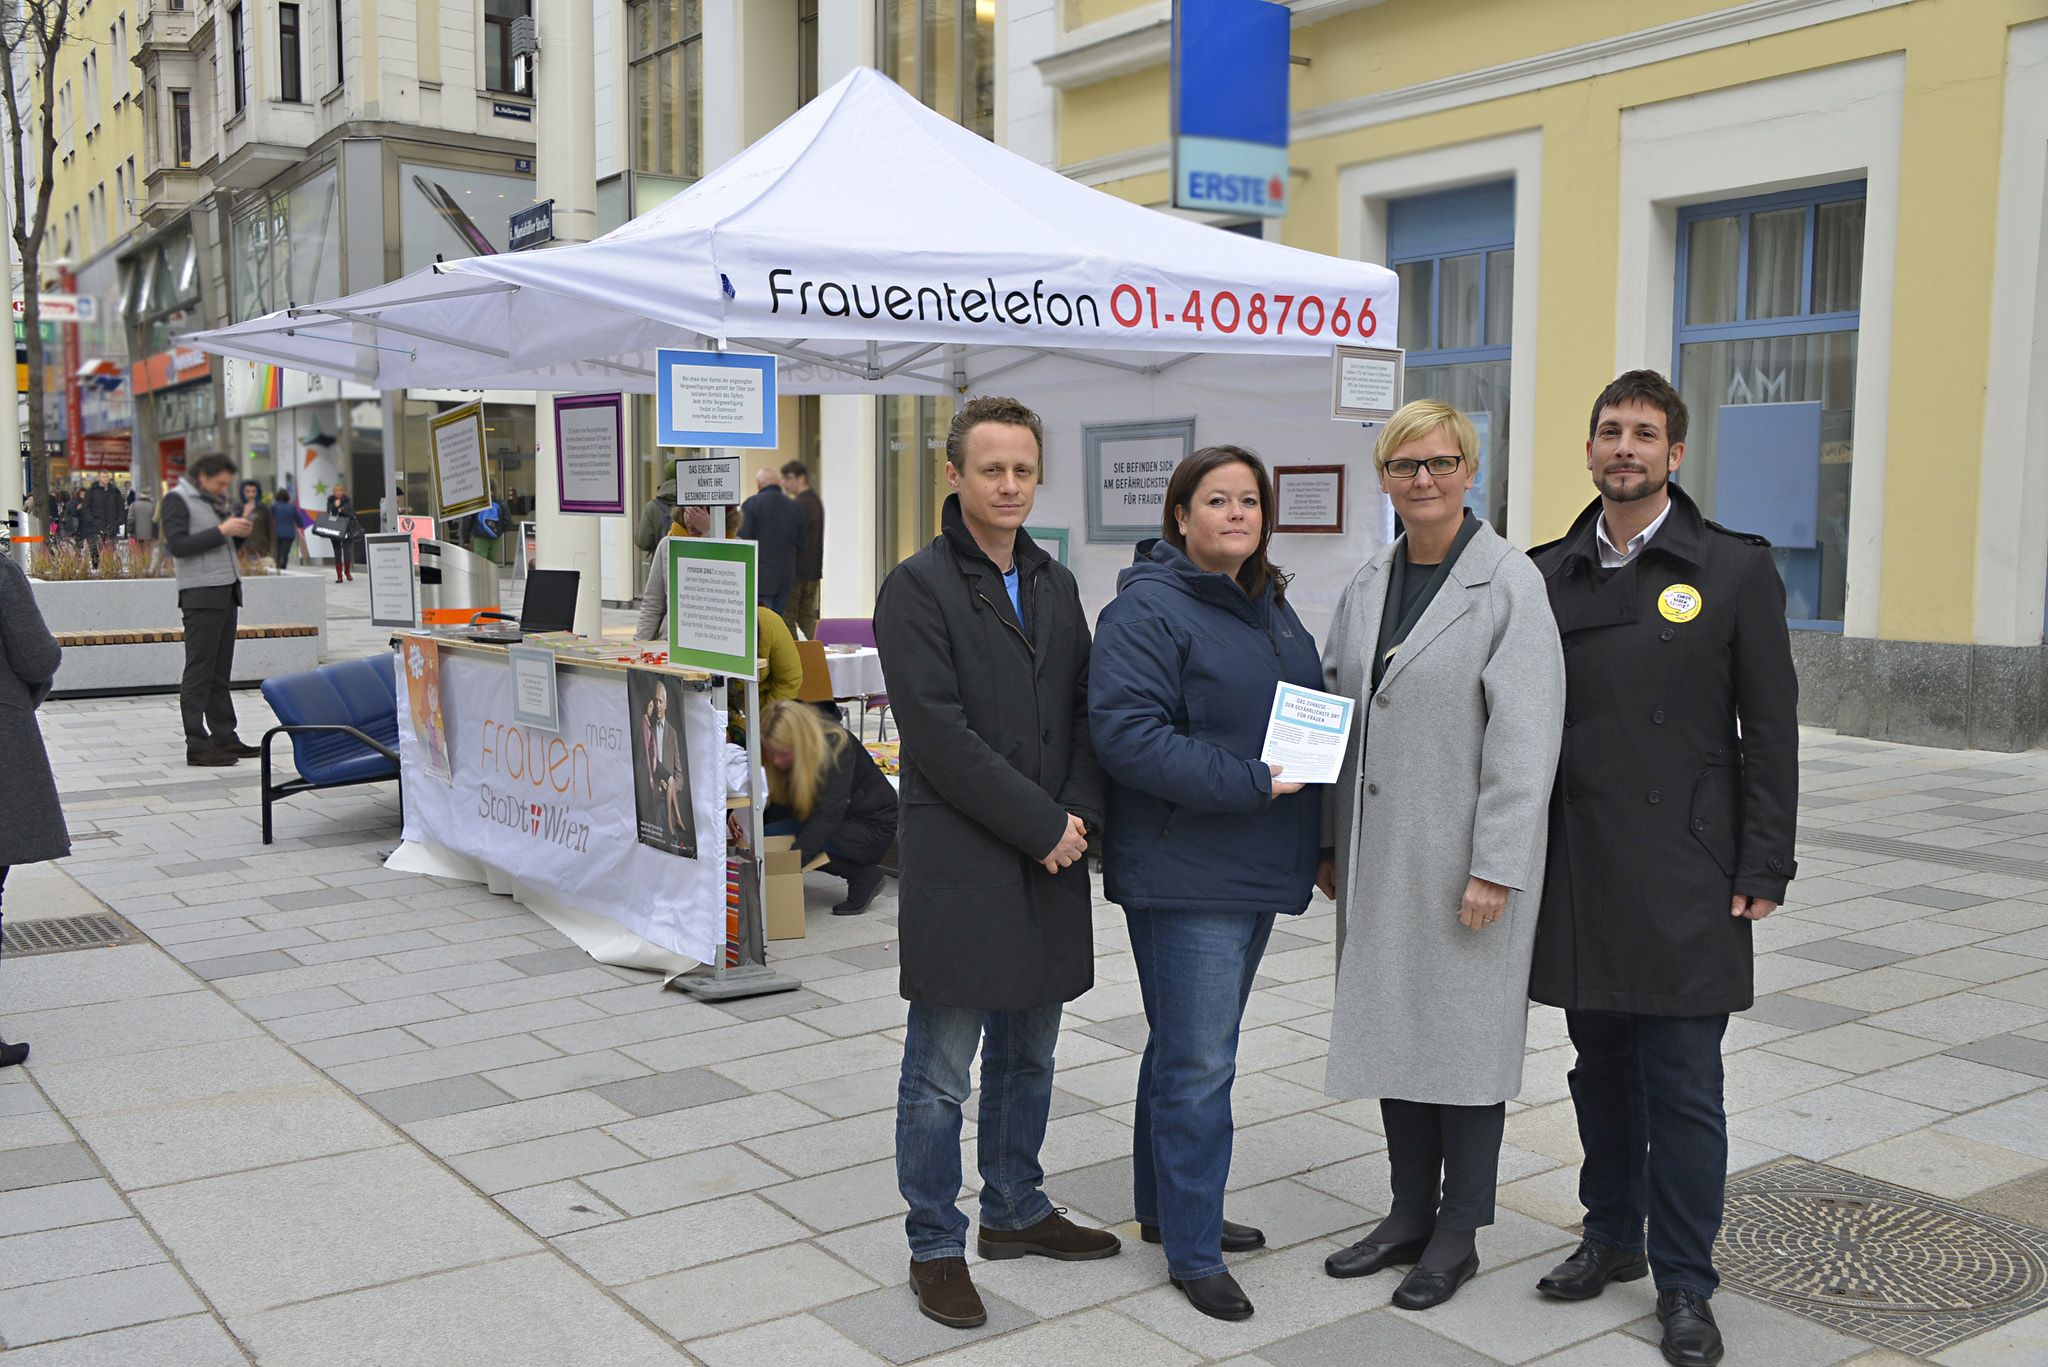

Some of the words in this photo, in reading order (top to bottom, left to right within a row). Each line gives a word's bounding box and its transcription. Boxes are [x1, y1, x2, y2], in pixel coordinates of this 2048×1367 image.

[520, 160, 526, 168] 8
[1189, 171, 1264, 206] ERSTE
[514, 220, 535, 238] Mariahilfer
[536, 215, 549, 231] Straße
[767, 268, 1101, 328] Frauentelefon
[1110, 283, 1377, 338] 01-4087066
[689, 465, 697, 474] DAS
[698, 464, 712, 473] EIGENE
[714, 464, 730, 473] ZUHAUSE
[1114, 463, 1124, 473] SIE
[1127, 462, 1157, 472] BEFINDEN
[1160, 461, 1173, 471] SICH
[698, 477, 712, 487] KÖNNTE
[714, 478, 723, 487] IHRE
[1104, 479, 1113, 489] AM
[1116, 476, 1168, 489] GEFÄHRLICHSTEN
[685, 491, 710, 500] GESUNDHEIT
[1124, 492, 1136, 504] FÜR
[1139, 494, 1163, 504] FRAUEN!
[1295, 704, 1330, 717] GEFÄHRLICHSTE
[1306, 700, 1326, 710] ZUHAUSE
[1307, 714, 1324, 723] FRAUEN
[481, 719, 592, 800] Frauen
[544, 803, 590, 853] Wien
